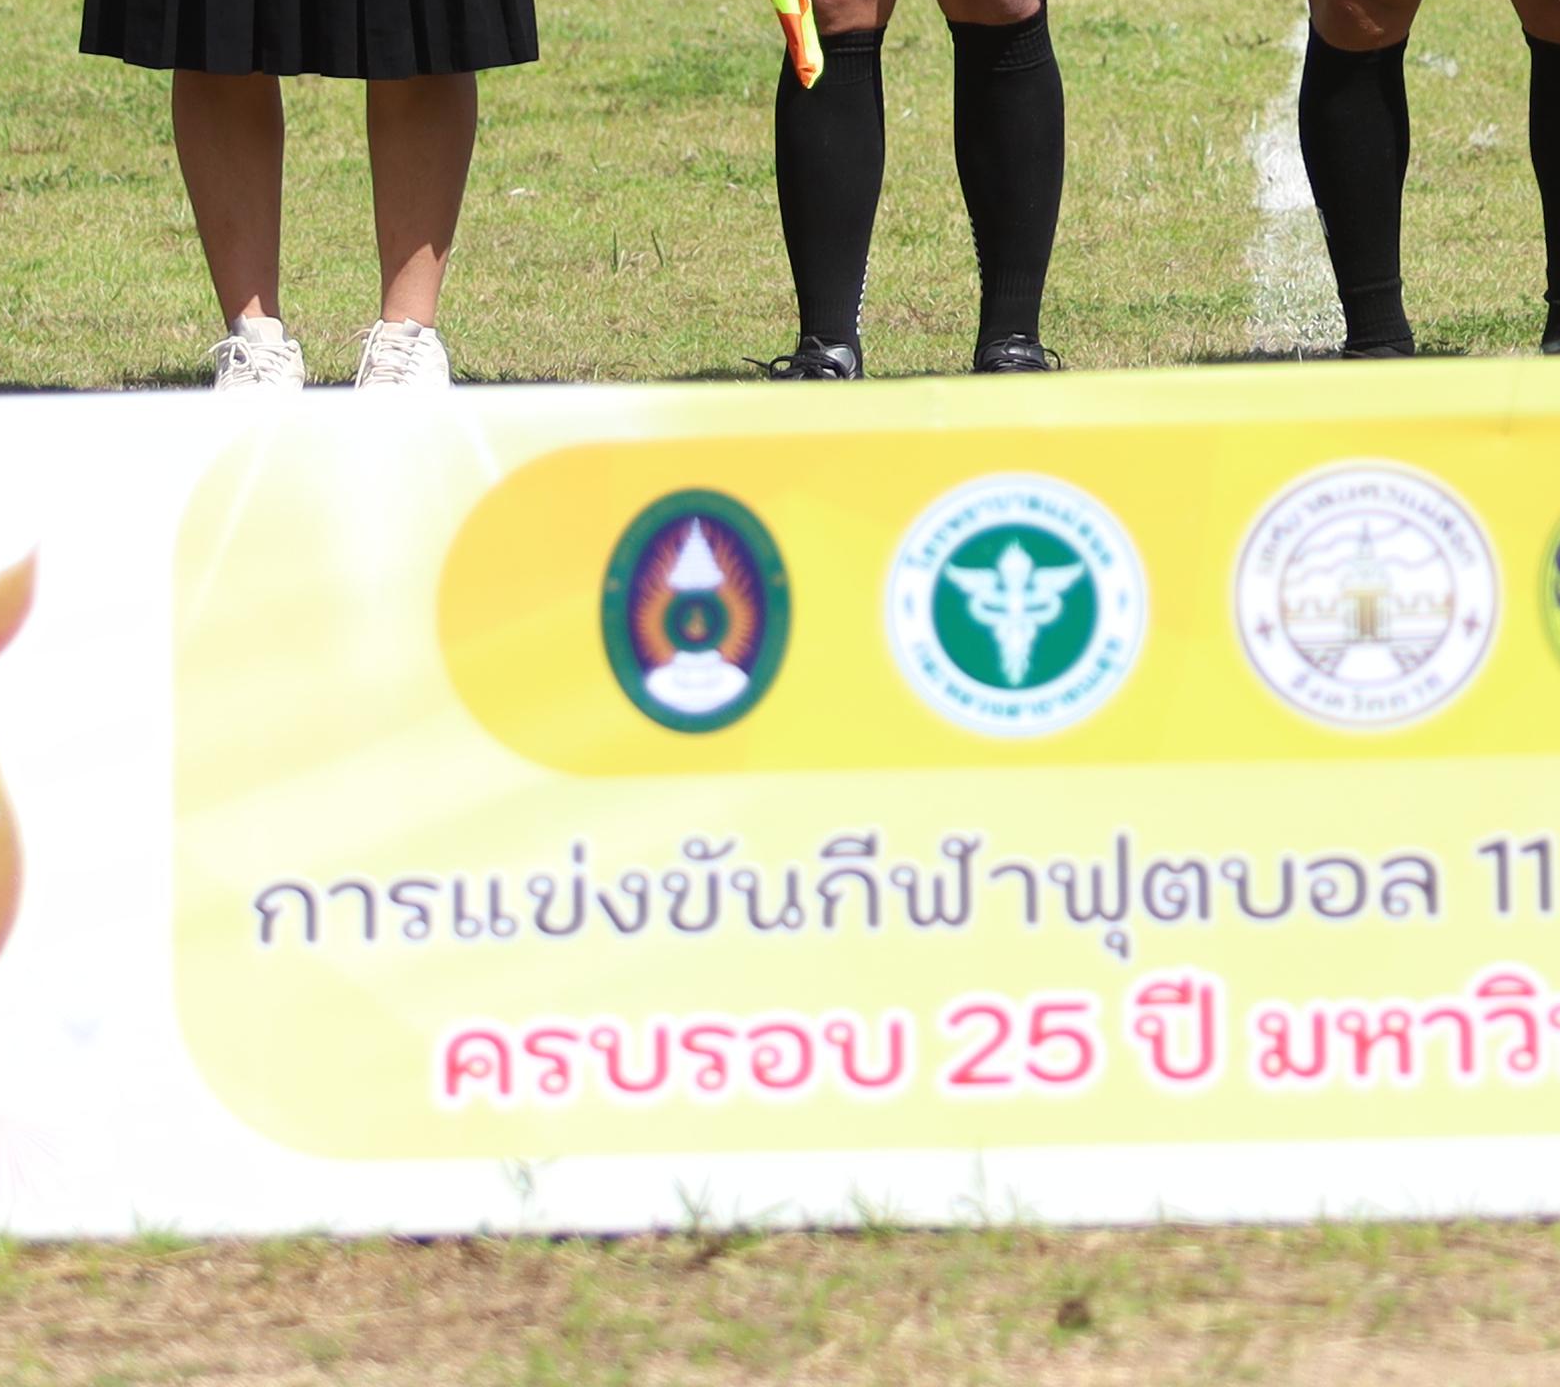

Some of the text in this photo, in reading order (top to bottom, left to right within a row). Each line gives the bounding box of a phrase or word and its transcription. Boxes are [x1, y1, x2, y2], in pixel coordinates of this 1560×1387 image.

[252, 831, 1441, 959] การแข่งขันกีฬาฟุตบอล
[1476, 838, 1554, 915] 11
[444, 1020, 906, 1097] ครบรอบ
[945, 1001, 1097, 1089] 25
[1135, 975, 1216, 1081] ปี
